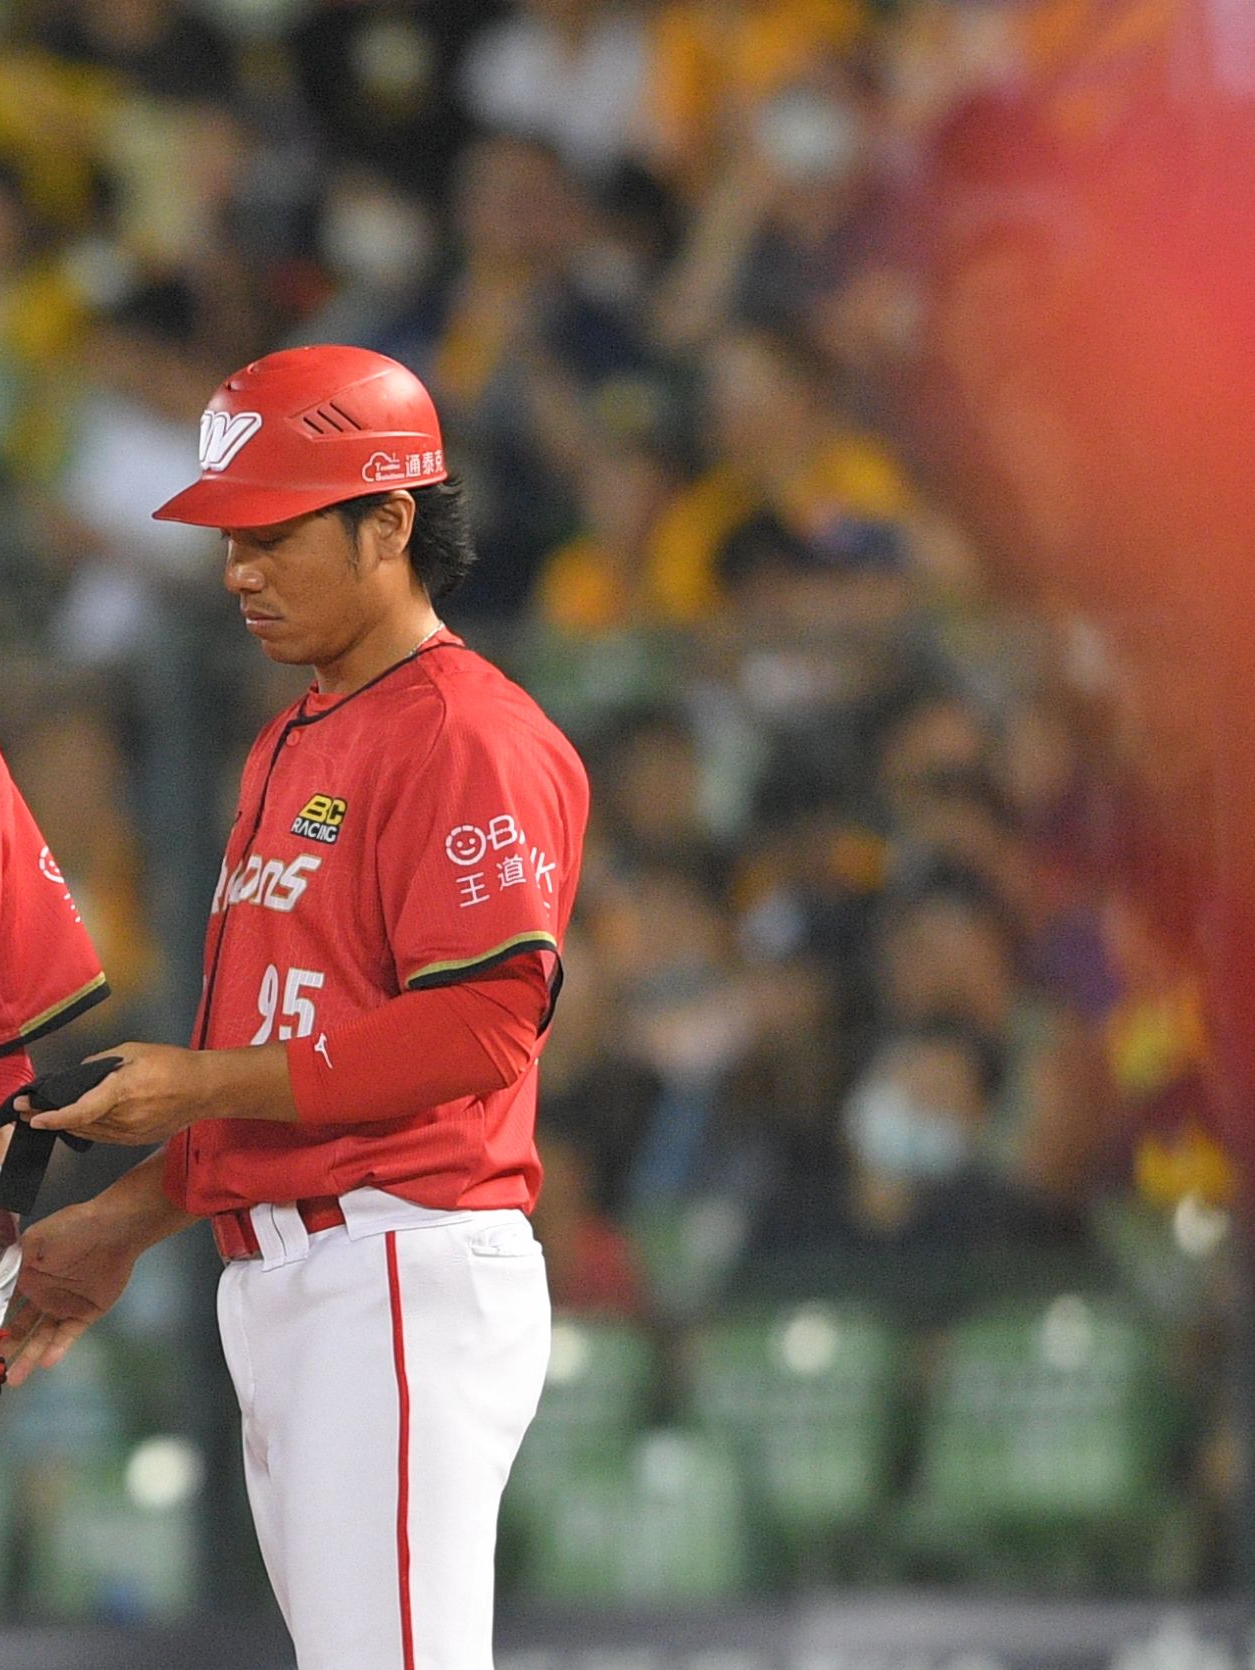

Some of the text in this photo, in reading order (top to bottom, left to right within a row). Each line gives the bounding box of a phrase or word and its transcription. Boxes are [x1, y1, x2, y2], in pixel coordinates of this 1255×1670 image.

[299, 794, 346, 826] BC
[291, 817, 338, 843] RACING
[249, 964, 325, 1046] 95
